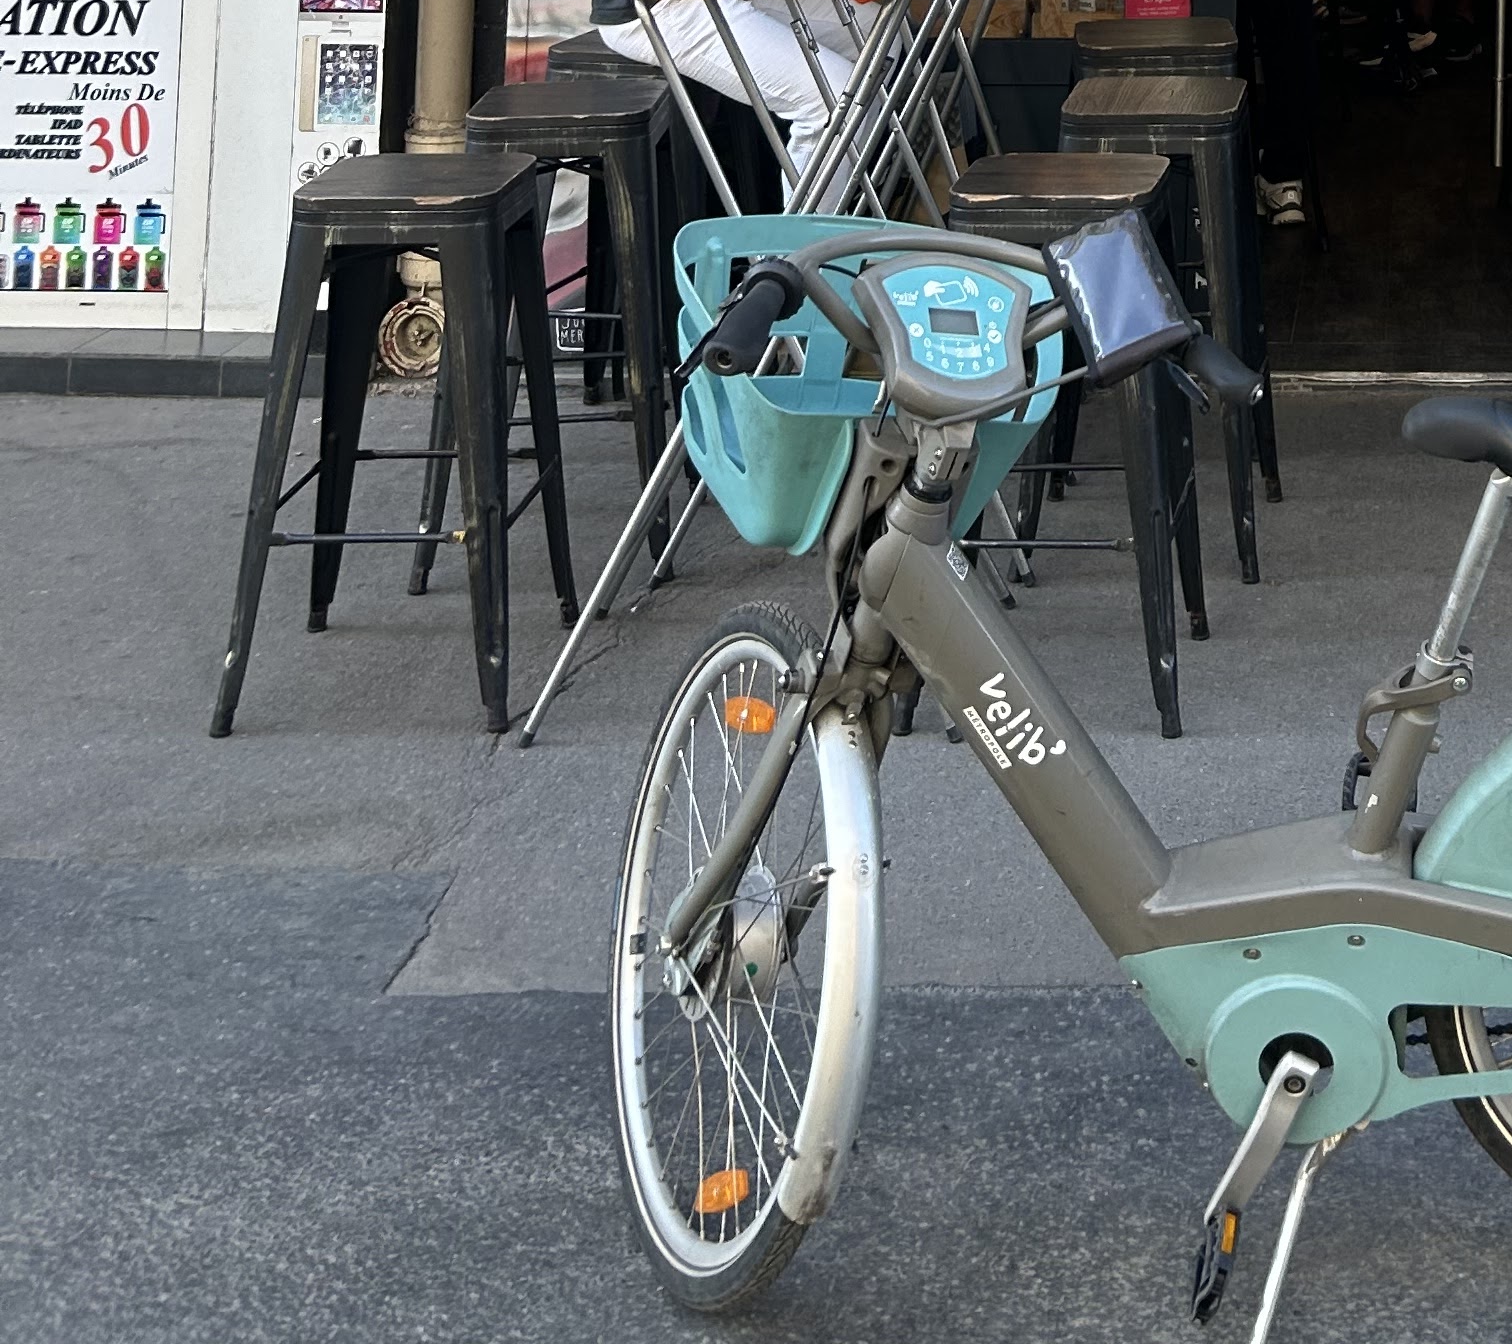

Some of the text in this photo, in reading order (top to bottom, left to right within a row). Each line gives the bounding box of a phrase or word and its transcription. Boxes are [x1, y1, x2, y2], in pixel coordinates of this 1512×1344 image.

[0, 0, 151, 37] ATION
[0, 50, 160, 75] -EXPRESS
[68, 83, 165, 101] Moins De
[50, 118, 84, 130] IPAD
[15, 134, 83, 146] TABLETTE
[86, 103, 149, 173] 30
[108, 154, 149, 179] Minutes
